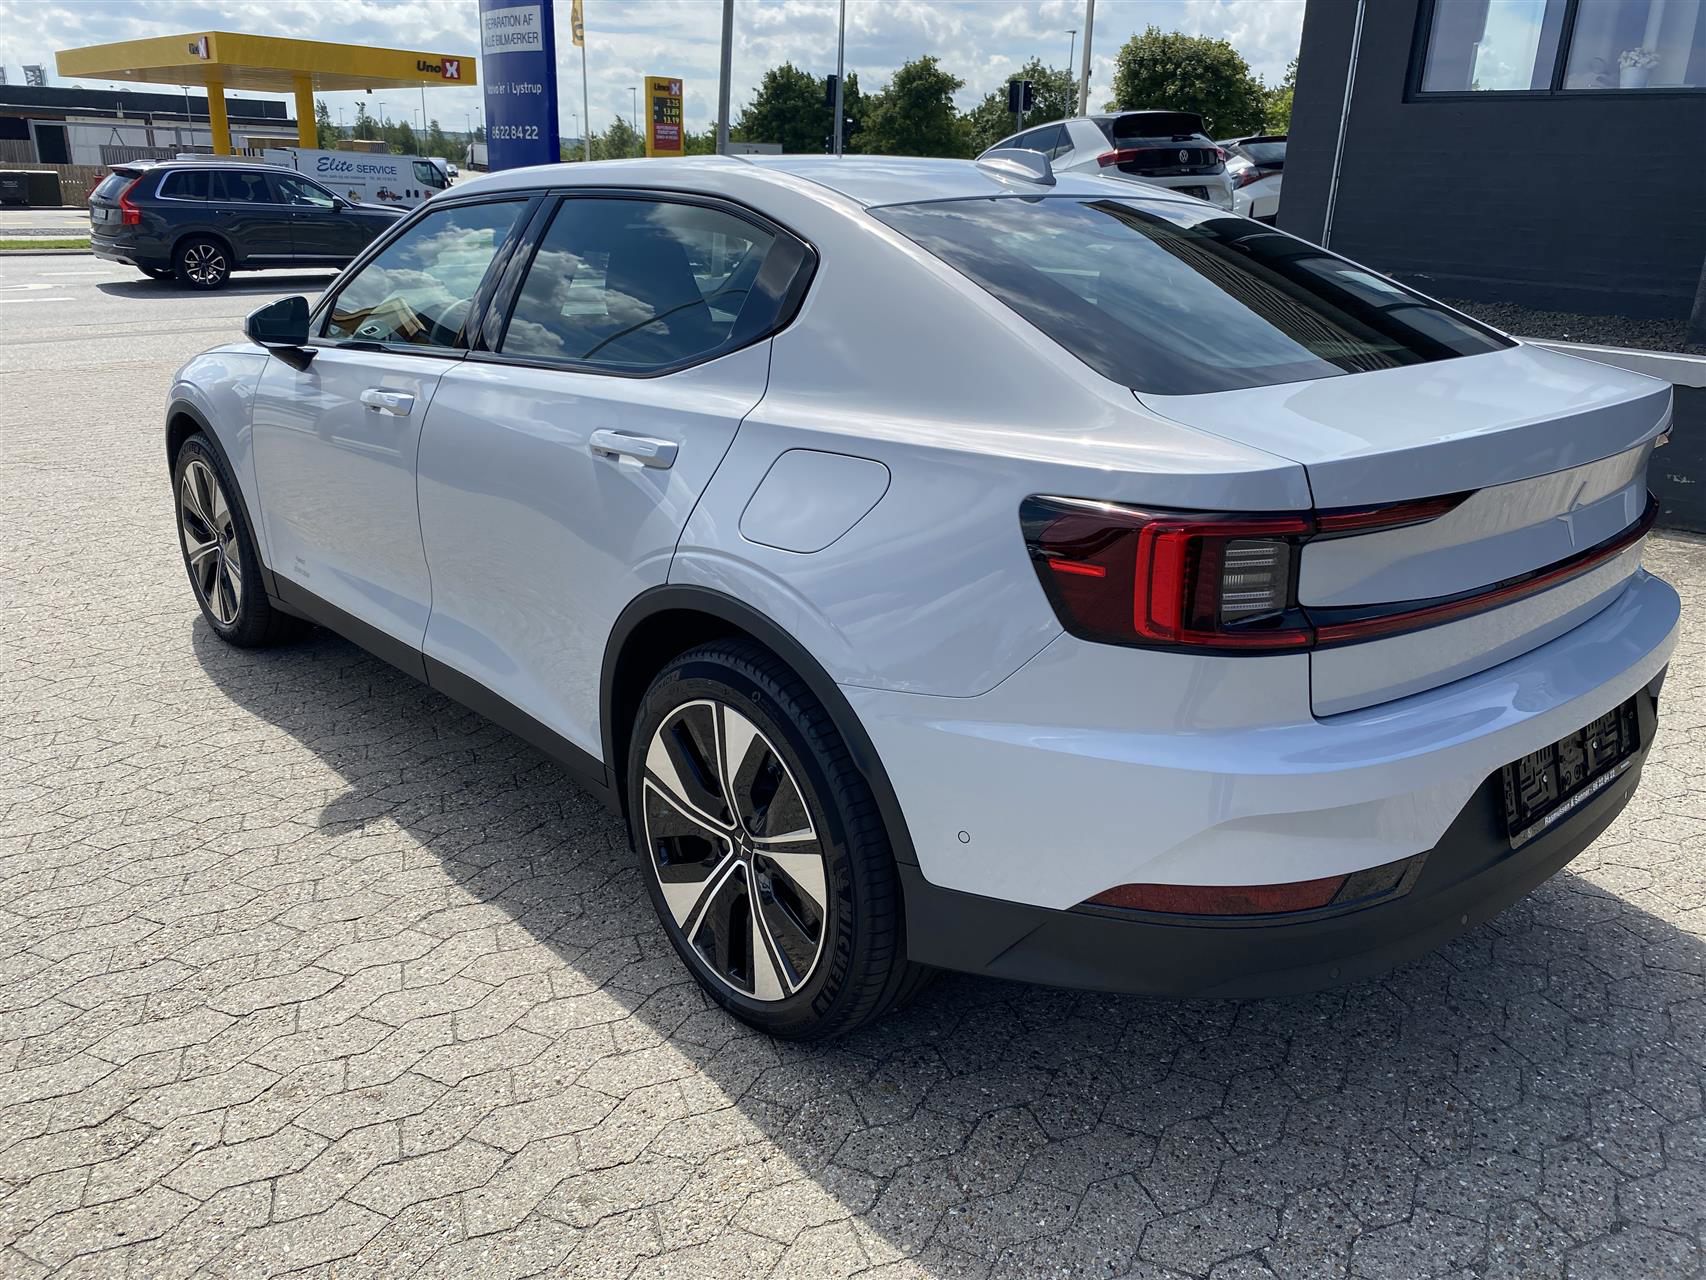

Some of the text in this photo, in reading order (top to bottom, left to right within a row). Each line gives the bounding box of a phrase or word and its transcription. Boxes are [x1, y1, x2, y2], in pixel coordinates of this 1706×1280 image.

[523, 13, 534, 26] AF
[511, 82, 542, 97] Lystrup
[511, 125, 523, 139] 84
[525, 125, 539, 140] 22
[316, 157, 397, 175] Elite SERVICE
